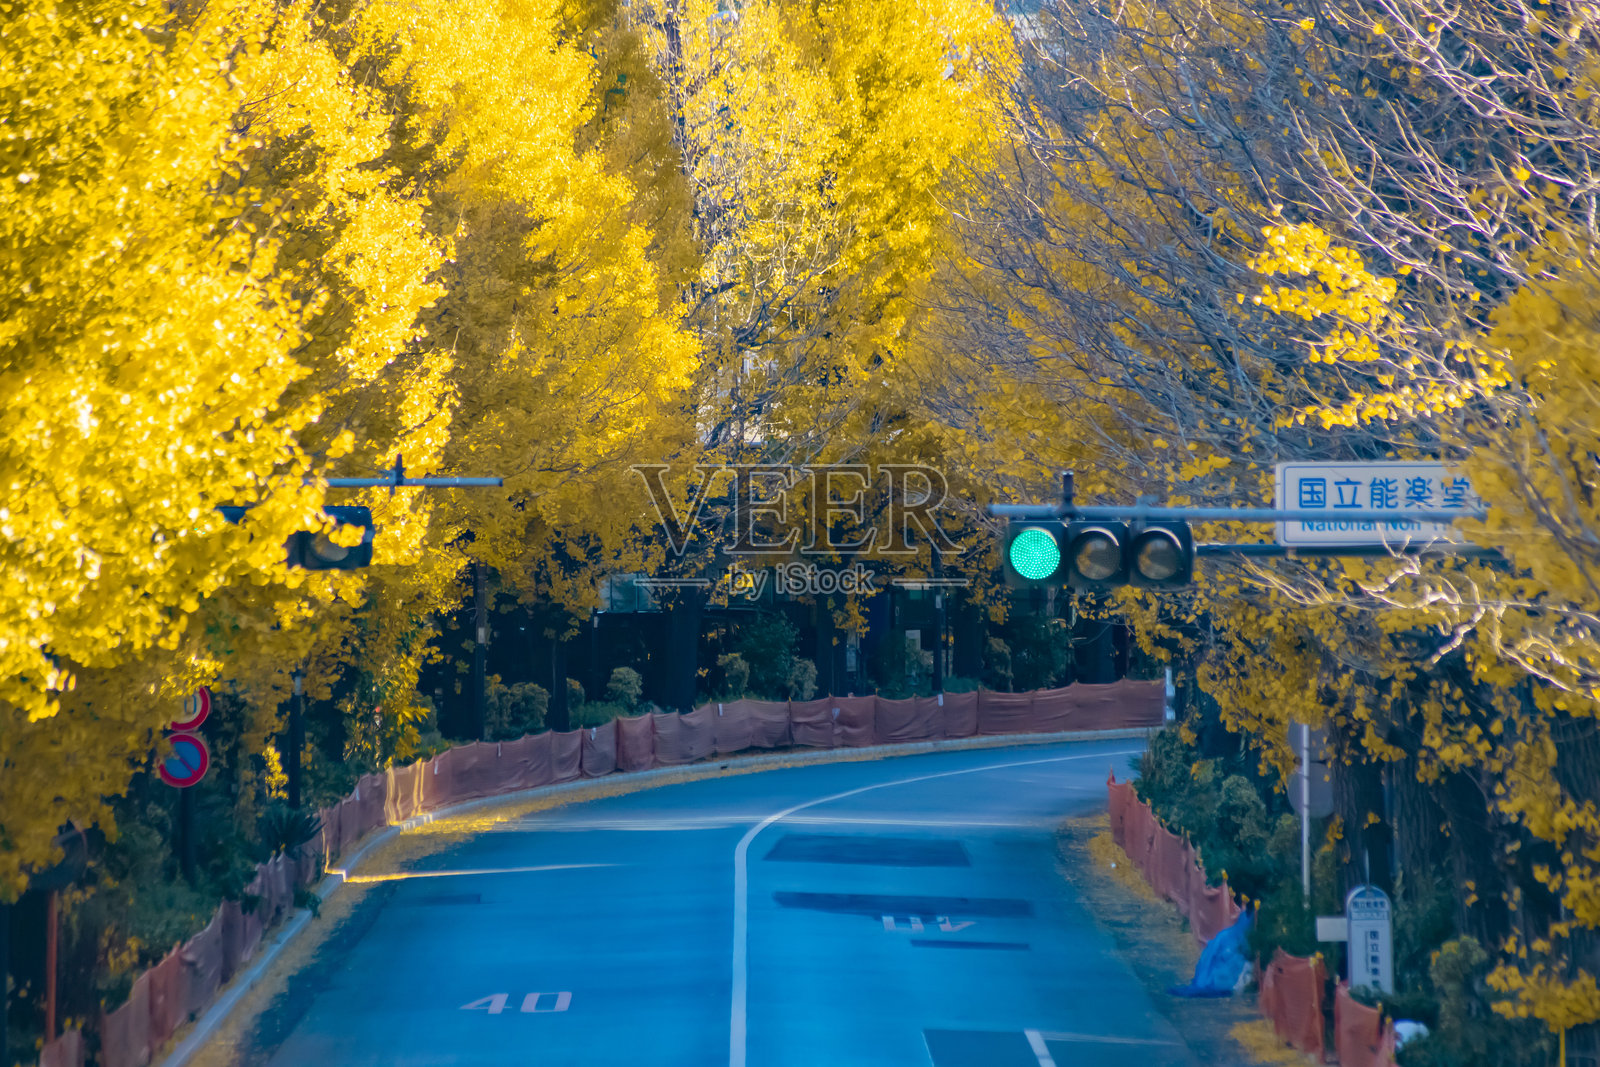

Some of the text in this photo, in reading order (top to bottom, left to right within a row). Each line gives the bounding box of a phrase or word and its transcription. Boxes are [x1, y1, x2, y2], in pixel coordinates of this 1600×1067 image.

[1298, 477, 1491, 509] 国立能楽堂
[459, 992, 572, 1014] 40
